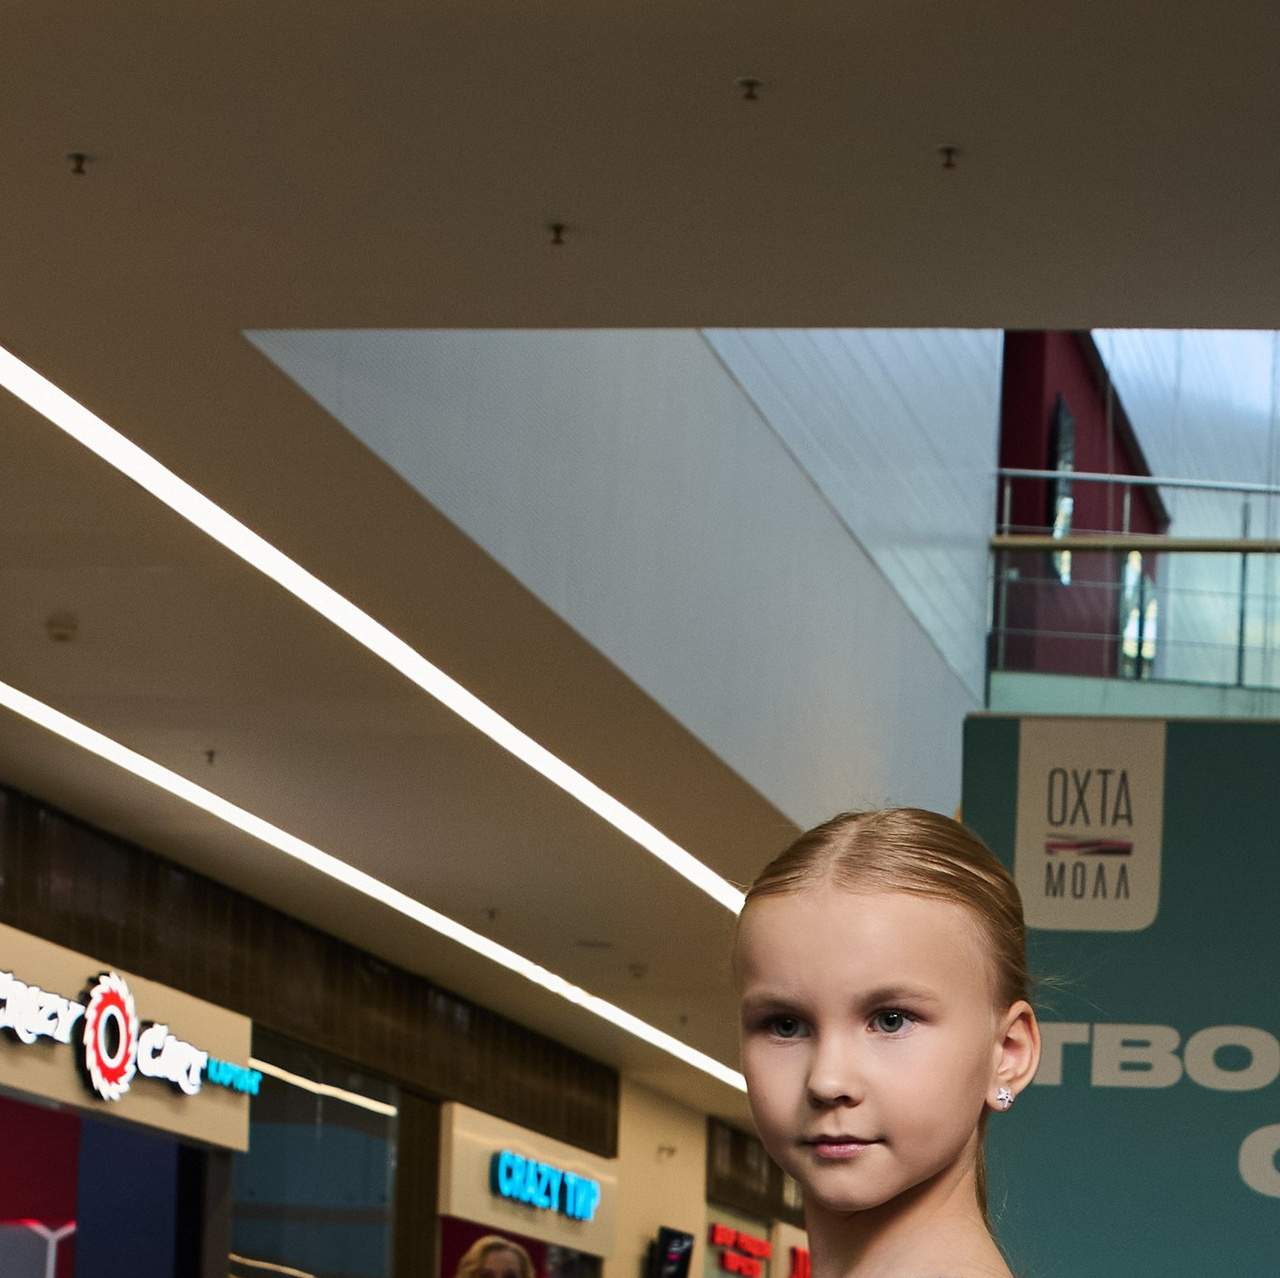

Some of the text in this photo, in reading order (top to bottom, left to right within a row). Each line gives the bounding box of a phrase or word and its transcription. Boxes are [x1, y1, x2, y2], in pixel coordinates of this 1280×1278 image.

[1047, 767, 1133, 827] ОХТА
[1045, 861, 1130, 899] МОЛЛ
[498, 1149, 564, 1212] CRAZY
